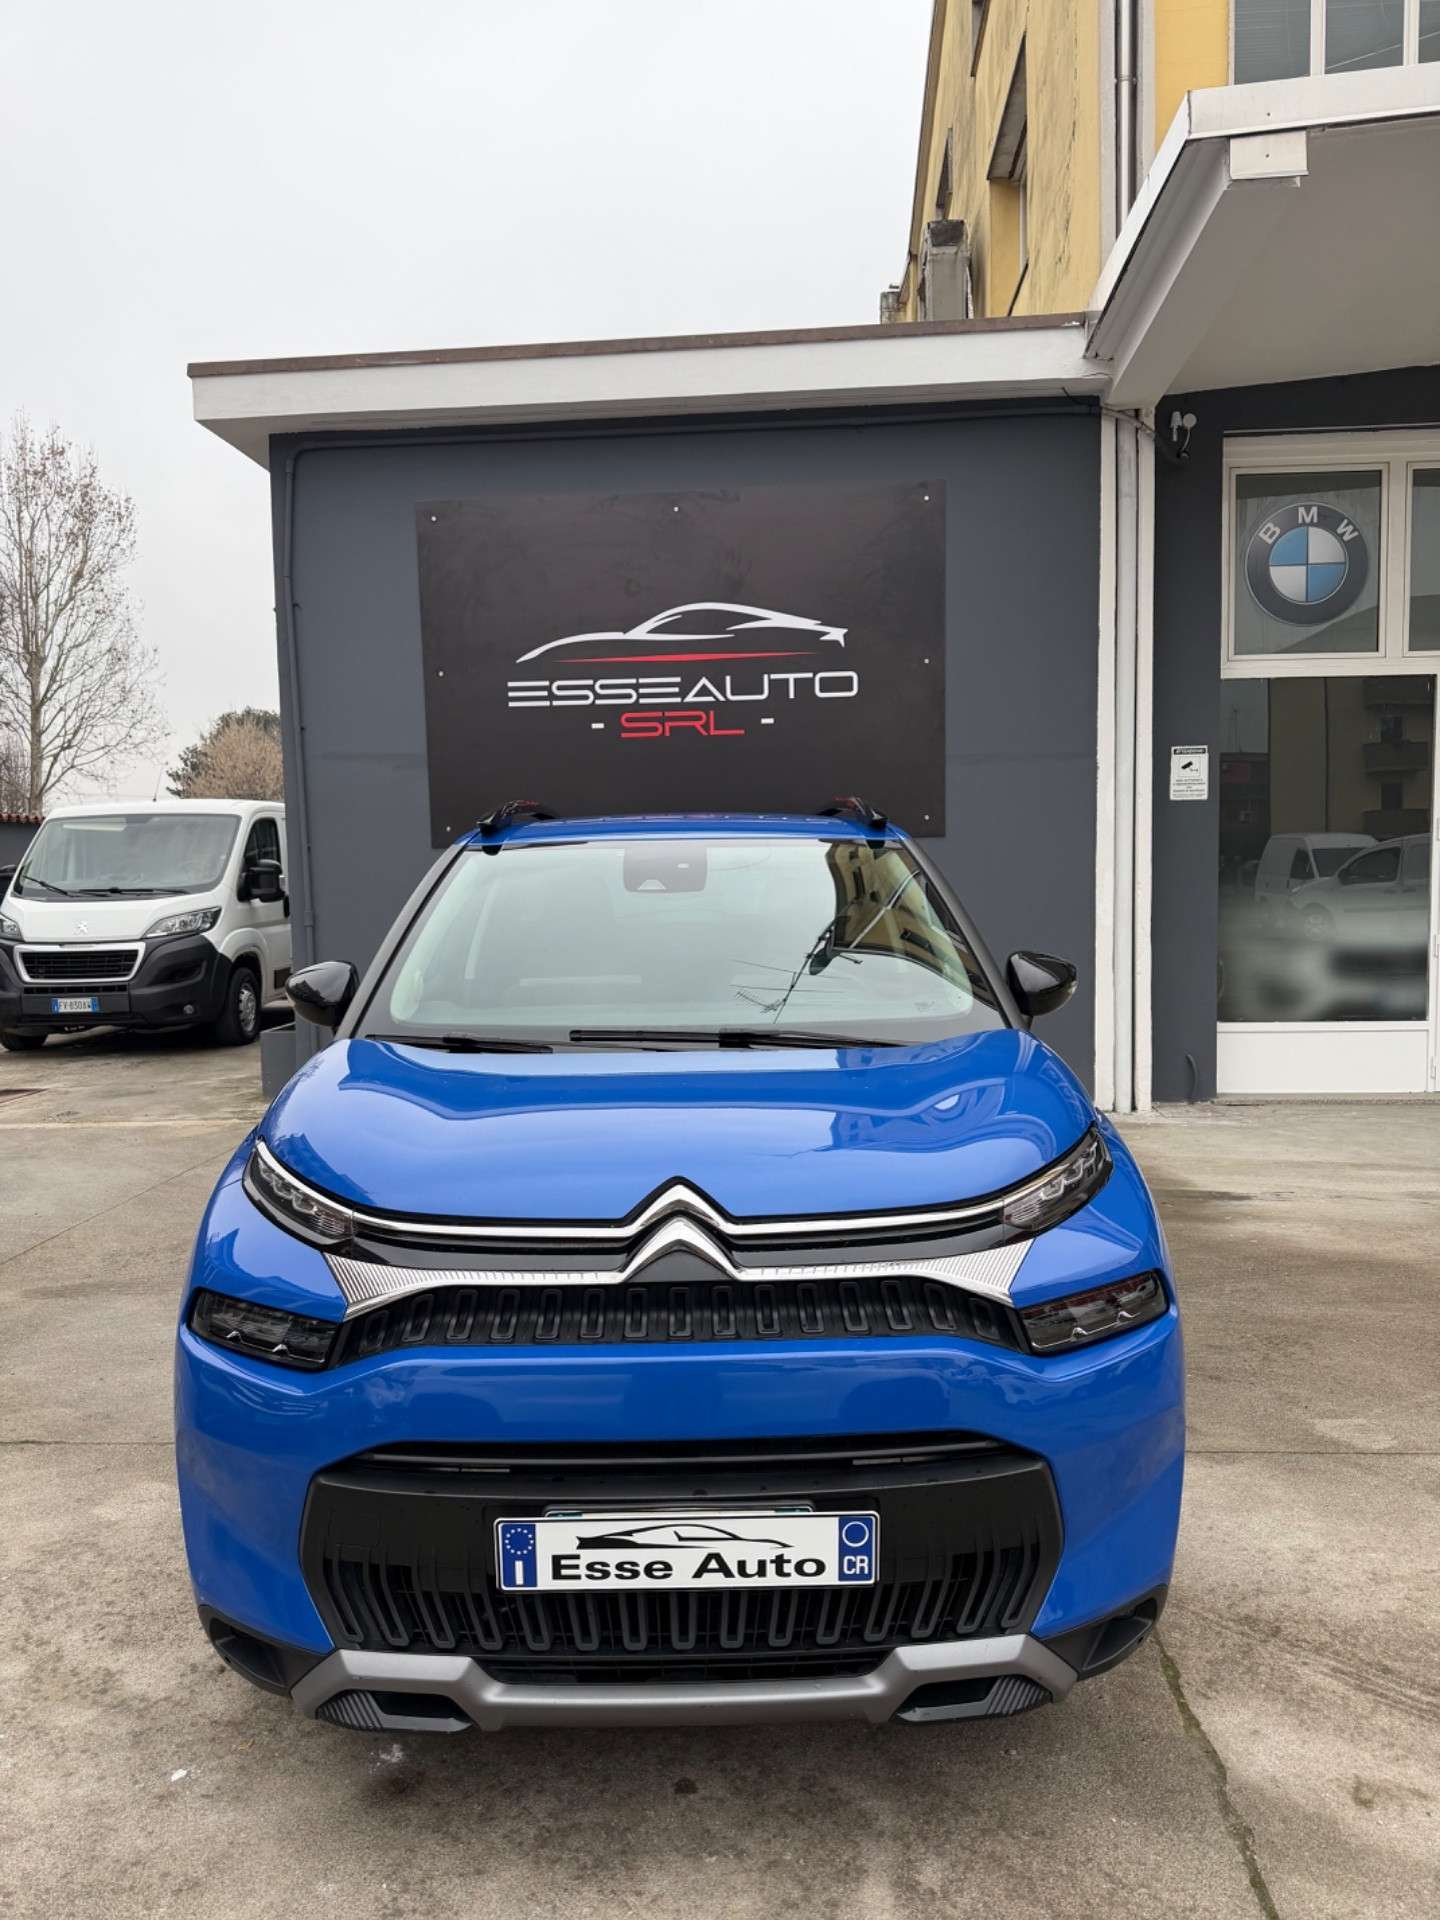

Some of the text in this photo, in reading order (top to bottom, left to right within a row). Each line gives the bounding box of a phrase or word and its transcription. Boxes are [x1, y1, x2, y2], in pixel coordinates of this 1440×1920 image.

[1258, 506, 1360, 545] BMW
[507, 671, 859, 707] ESSEAUTO
[620, 710, 745, 738] SRL
[551, 1552, 827, 1581] Esse Auto
[843, 1555, 869, 1576] CR
